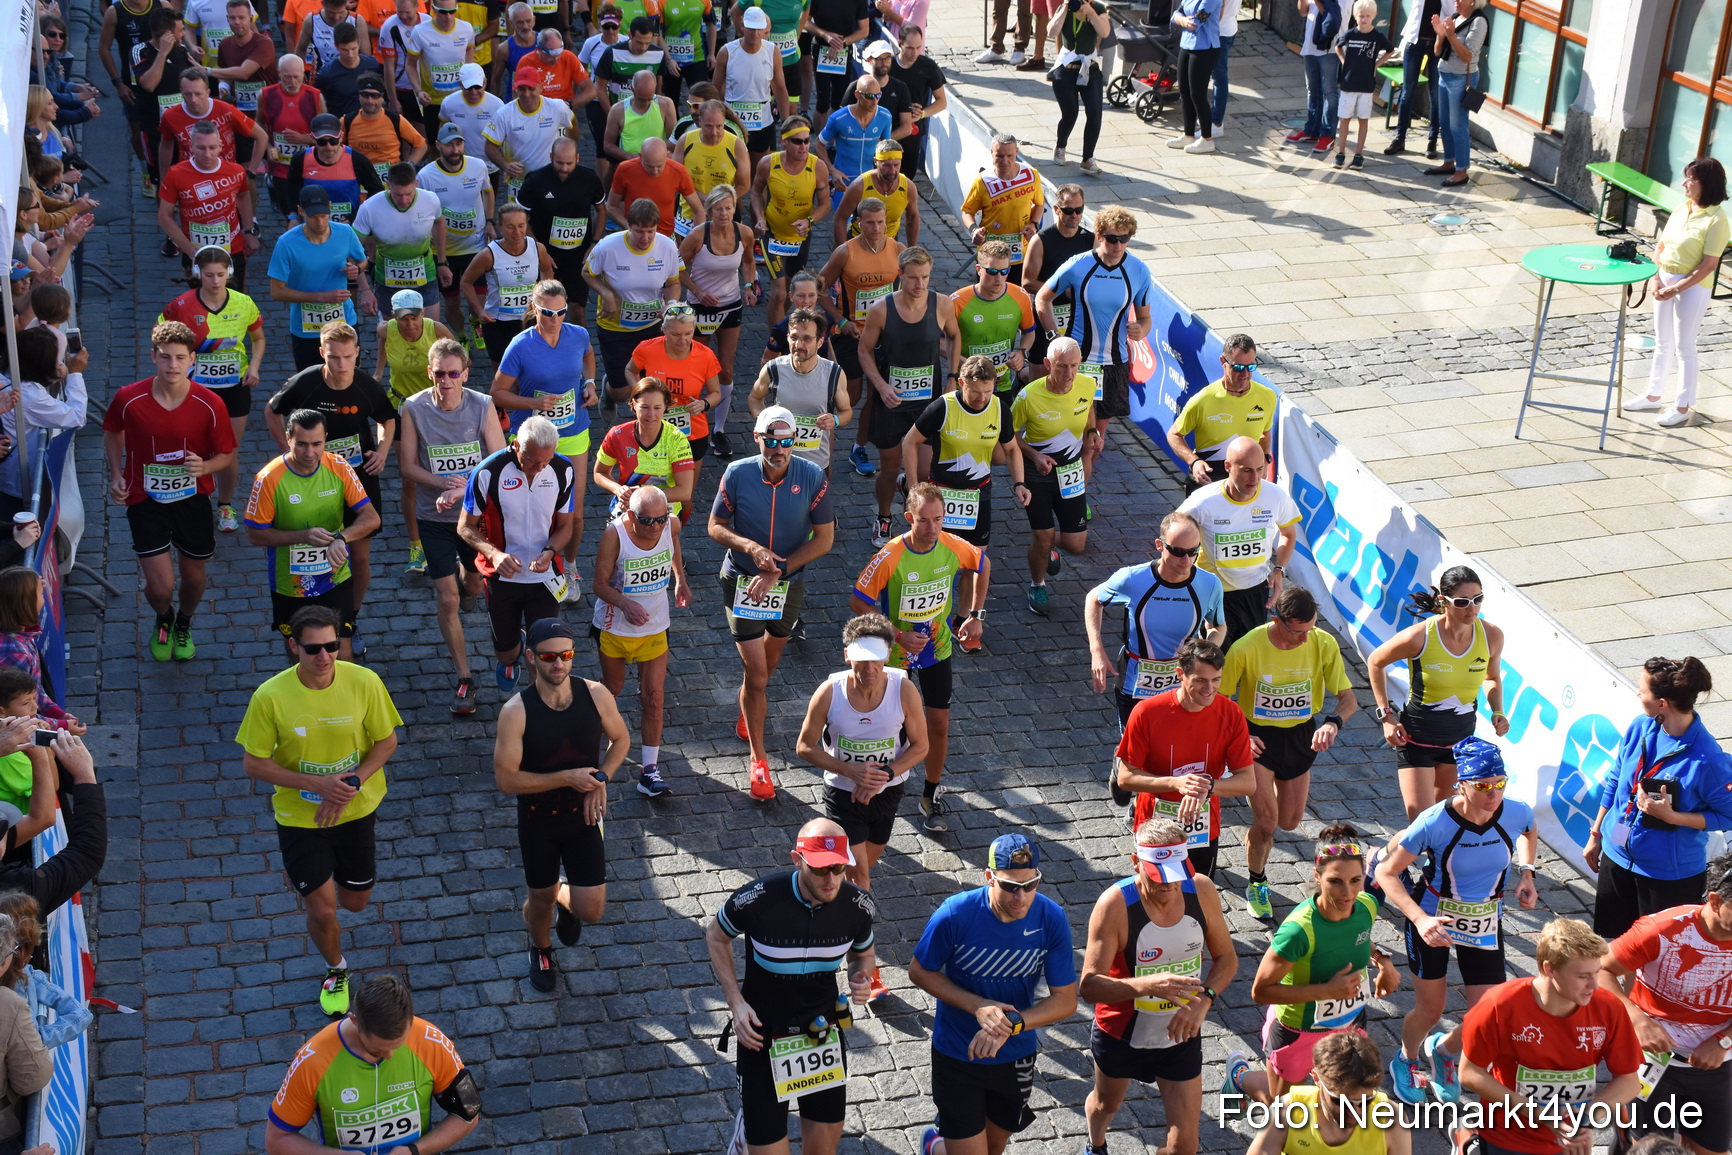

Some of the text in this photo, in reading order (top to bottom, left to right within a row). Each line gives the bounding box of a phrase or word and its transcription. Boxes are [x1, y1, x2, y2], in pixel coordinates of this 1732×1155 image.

[668, 47, 691, 57] 2505
[991, 186, 1036, 207] MAX BÖGL
[445, 218, 474, 230] 1363
[554, 220, 585, 228] BOCK
[195, 235, 225, 245] 1173
[556, 228, 583, 240] 1048
[391, 268, 420, 279] 1217
[625, 302, 660, 310] BOCK
[308, 310, 339, 322] 1160
[624, 311, 657, 321] 2739
[199, 353, 237, 362] BOCK
[201, 364, 235, 376] 2686
[894, 368, 929, 376] BOCK
[895, 377, 928, 389] 2156
[1168, 366, 1190, 394] ONLINE
[437, 457, 477, 471] 2034
[151, 477, 190, 491] 2562
[504, 477, 517, 486] tkn
[156, 491, 186, 500] FABIAN
[943, 502, 974, 516] 019
[1220, 532, 1261, 543] BOCK
[1221, 543, 1261, 558] 1395
[629, 554, 668, 571] BOCK
[630, 566, 666, 585] 2084
[630, 582, 665, 593] ANDREAS
[907, 579, 948, 595] BOCK
[907, 591, 945, 610] 1279
[739, 608, 776, 619] CHRISTOF
[903, 606, 943, 618] FRIEDEMANN
[1261, 685, 1307, 696] BOCK
[1261, 696, 1306, 709] 2006
[844, 741, 891, 752] BOCK
[306, 755, 356, 774] BOCK
[1445, 901, 1492, 915] BOCK
[808, 936, 849, 945] TRIATHLON
[1141, 947, 1157, 959] tkn
[1512, 1032, 1533, 1043] Spitz
[782, 1048, 835, 1077] 1196
[1525, 1070, 1588, 1080] BOCK
[388, 1080, 417, 1092] BOCK
[787, 1072, 834, 1092] ANDREAS
[1525, 1084, 1586, 1101] 2247
[342, 1097, 410, 1126] BOCK
[347, 1117, 413, 1146] 2729
